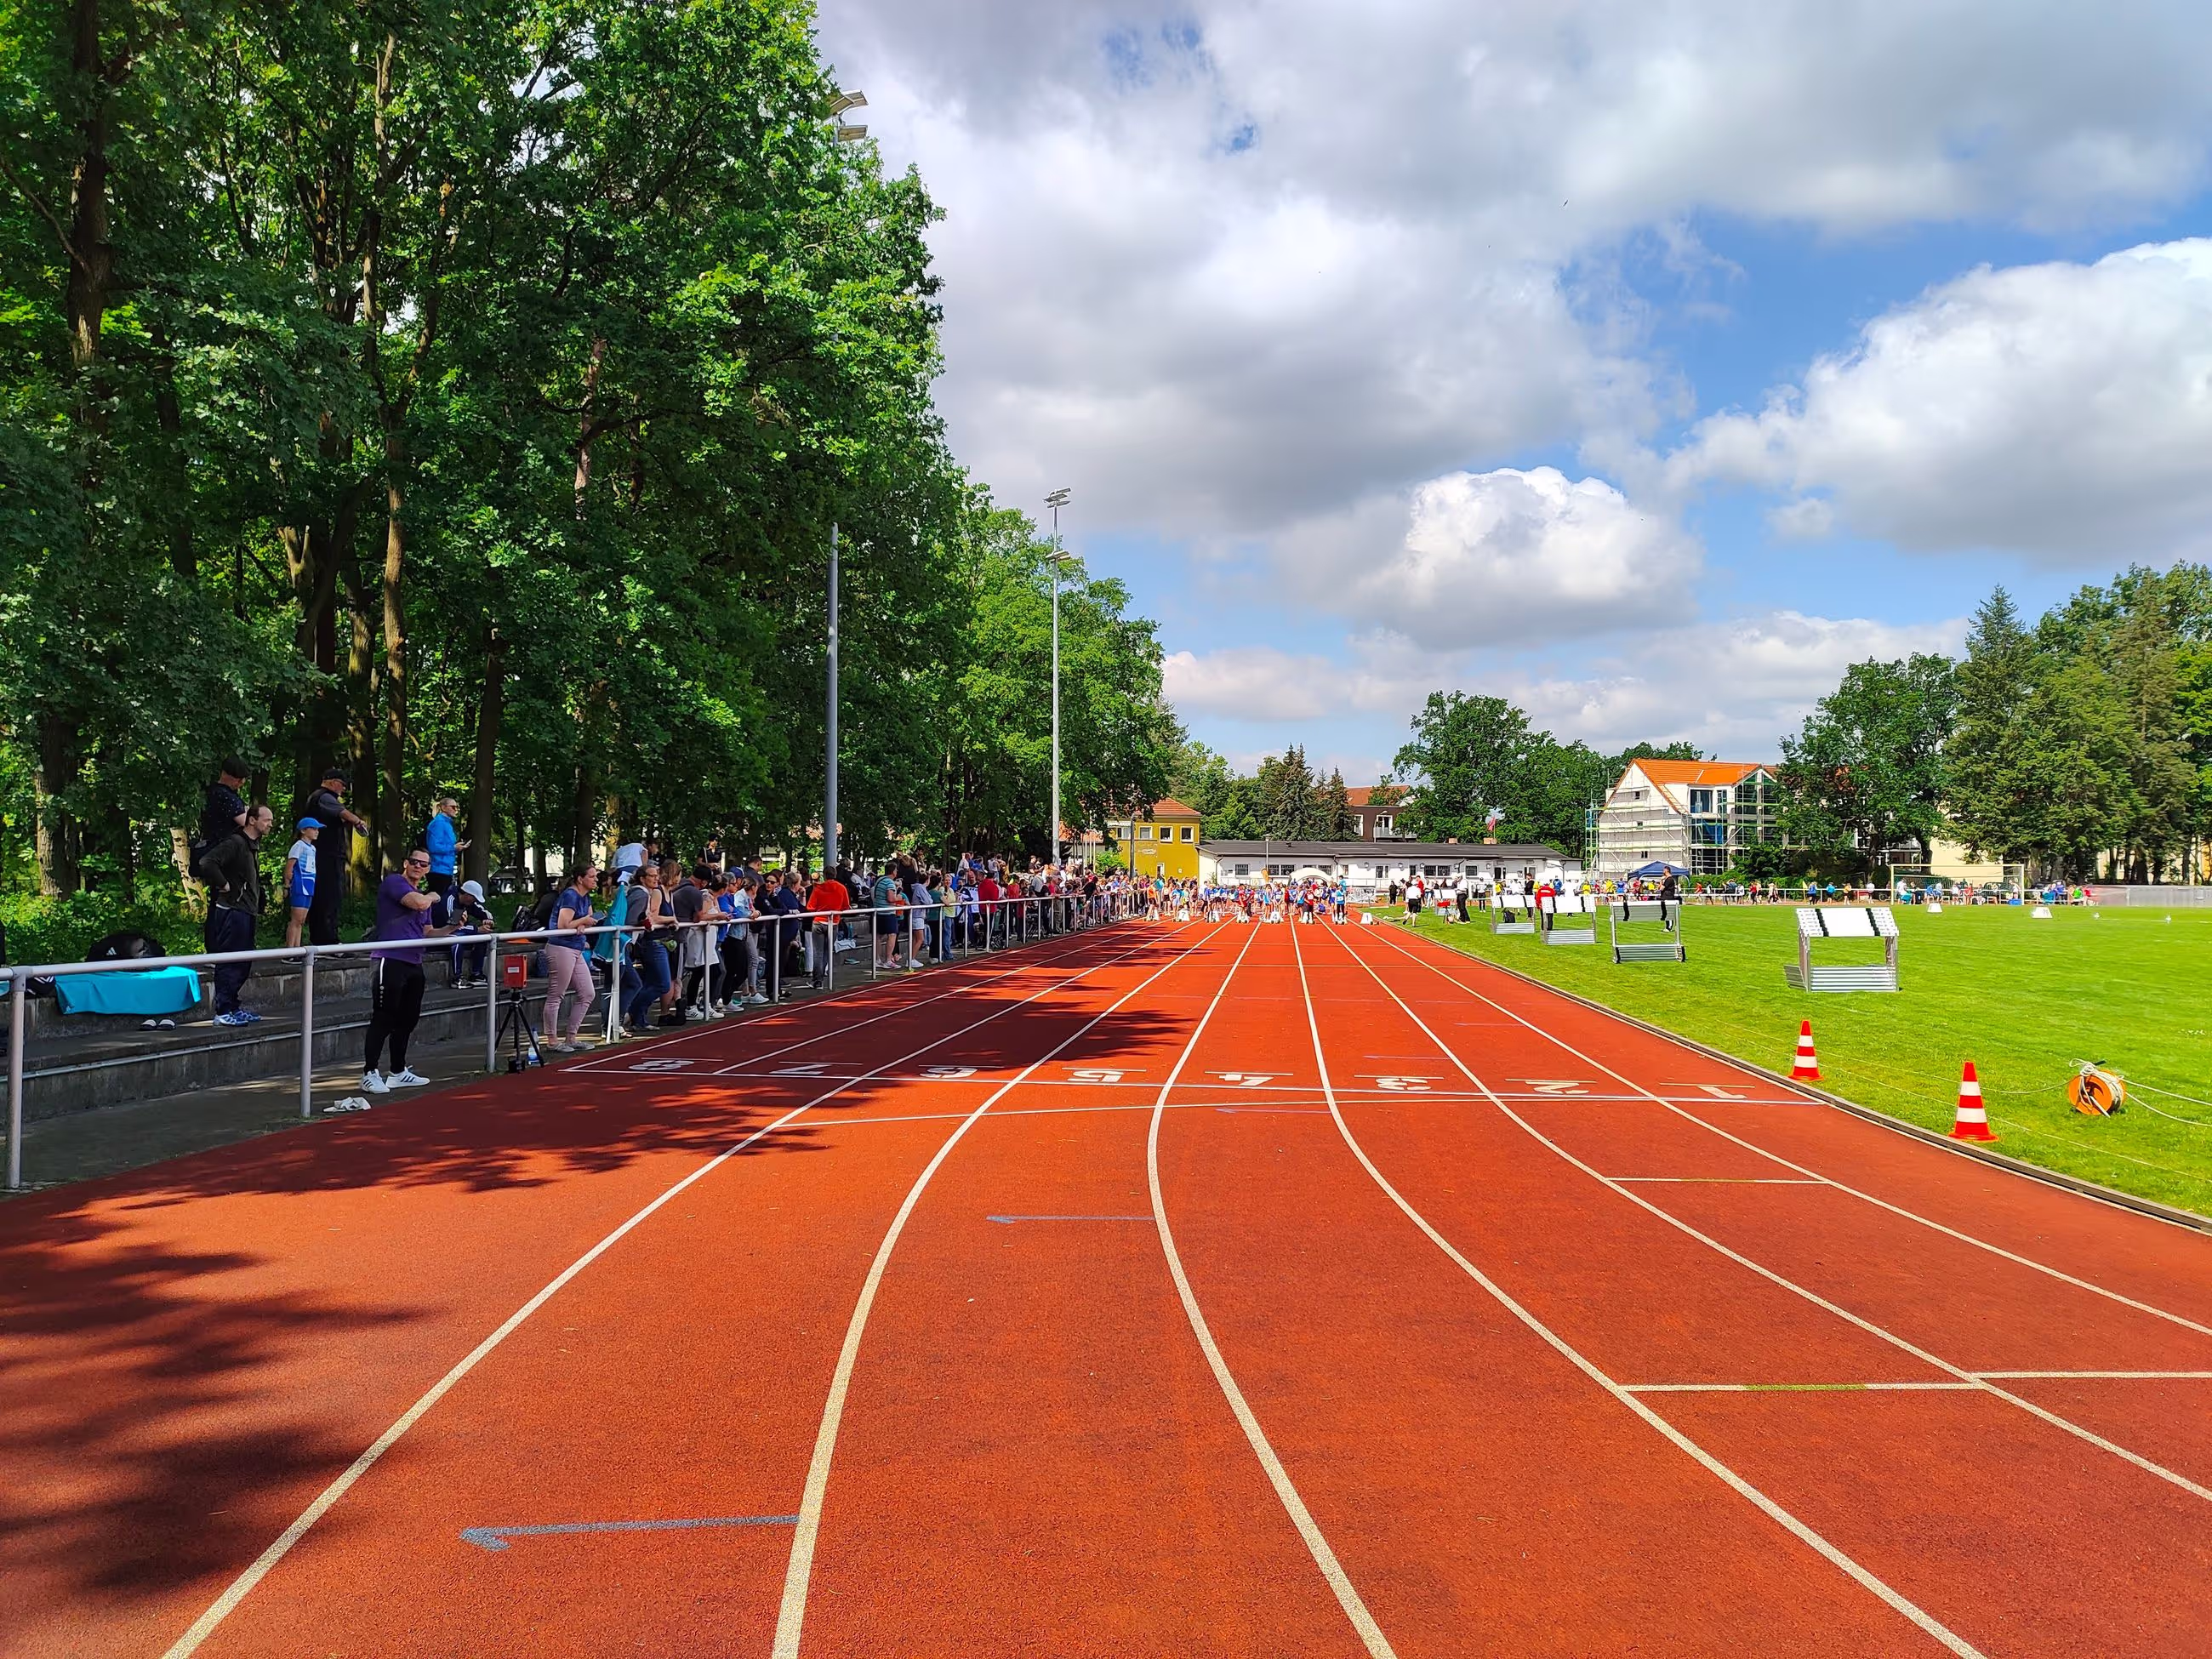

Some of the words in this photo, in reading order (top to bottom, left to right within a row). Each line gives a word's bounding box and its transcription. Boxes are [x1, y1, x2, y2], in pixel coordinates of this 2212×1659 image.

[628, 1059, 695, 1071] 8
[768, 1063, 833, 1075] 7
[919, 1066, 978, 1079] 6
[1067, 1070, 1125, 1083] 5
[1218, 1074, 1274, 1086] 4
[1375, 1077, 1432, 1091] 3
[1525, 1080, 1590, 1095] 2
[1696, 1086, 1747, 1099] 1
